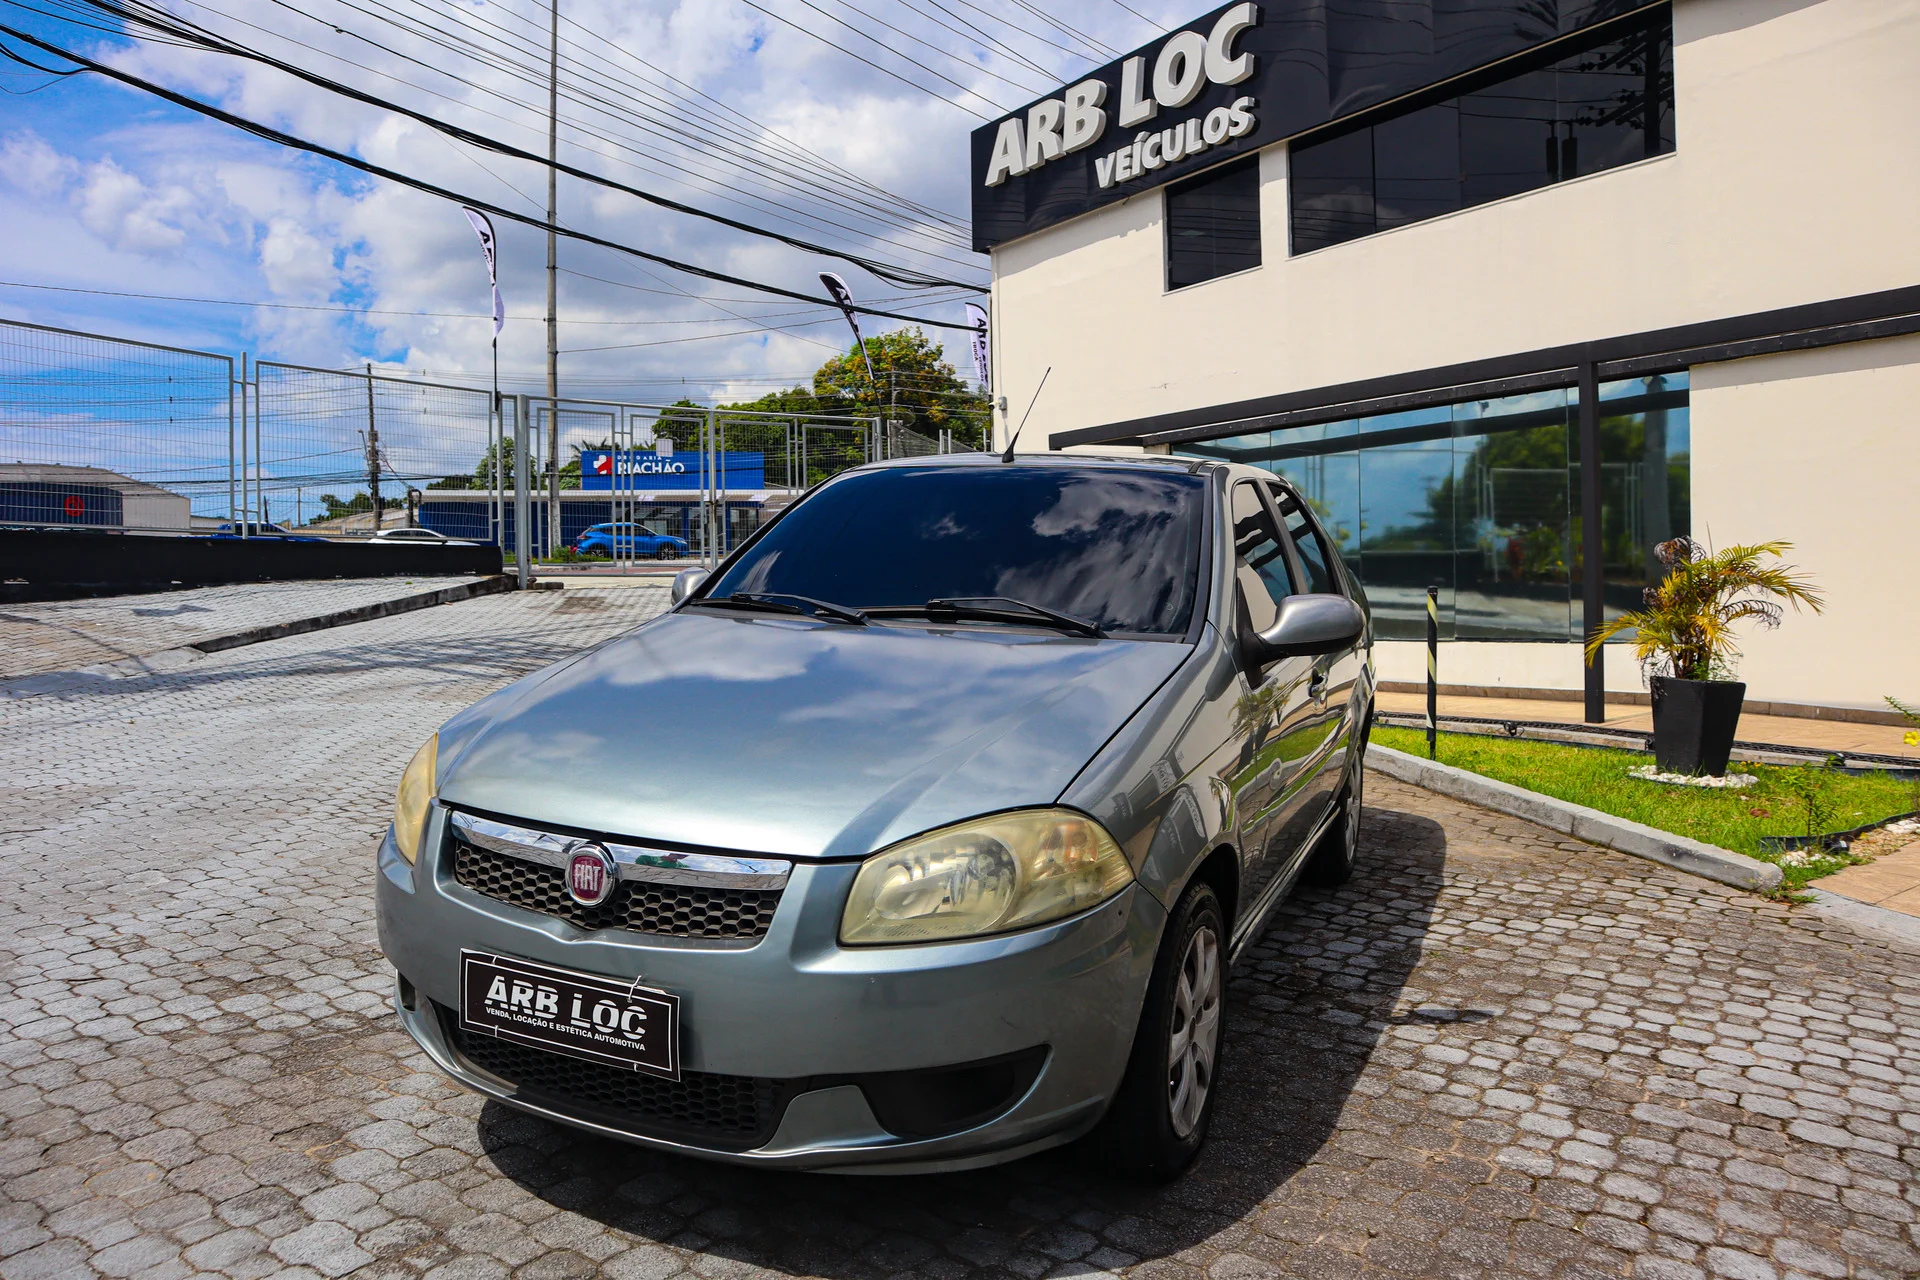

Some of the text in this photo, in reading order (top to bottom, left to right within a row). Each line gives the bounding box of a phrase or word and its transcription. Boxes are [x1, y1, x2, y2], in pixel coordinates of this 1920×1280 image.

[984, 2, 1258, 188] ARB LOC
[1095, 96, 1256, 189] VEÍCULOS
[617, 459, 685, 475] RIACHÃO
[574, 863, 601, 892] FIAT
[484, 975, 648, 1040] ARB LOC
[485, 1006, 646, 1051] VENDA, LOCAÇÃO E ESTÉTICA AUTOMOTIVA
